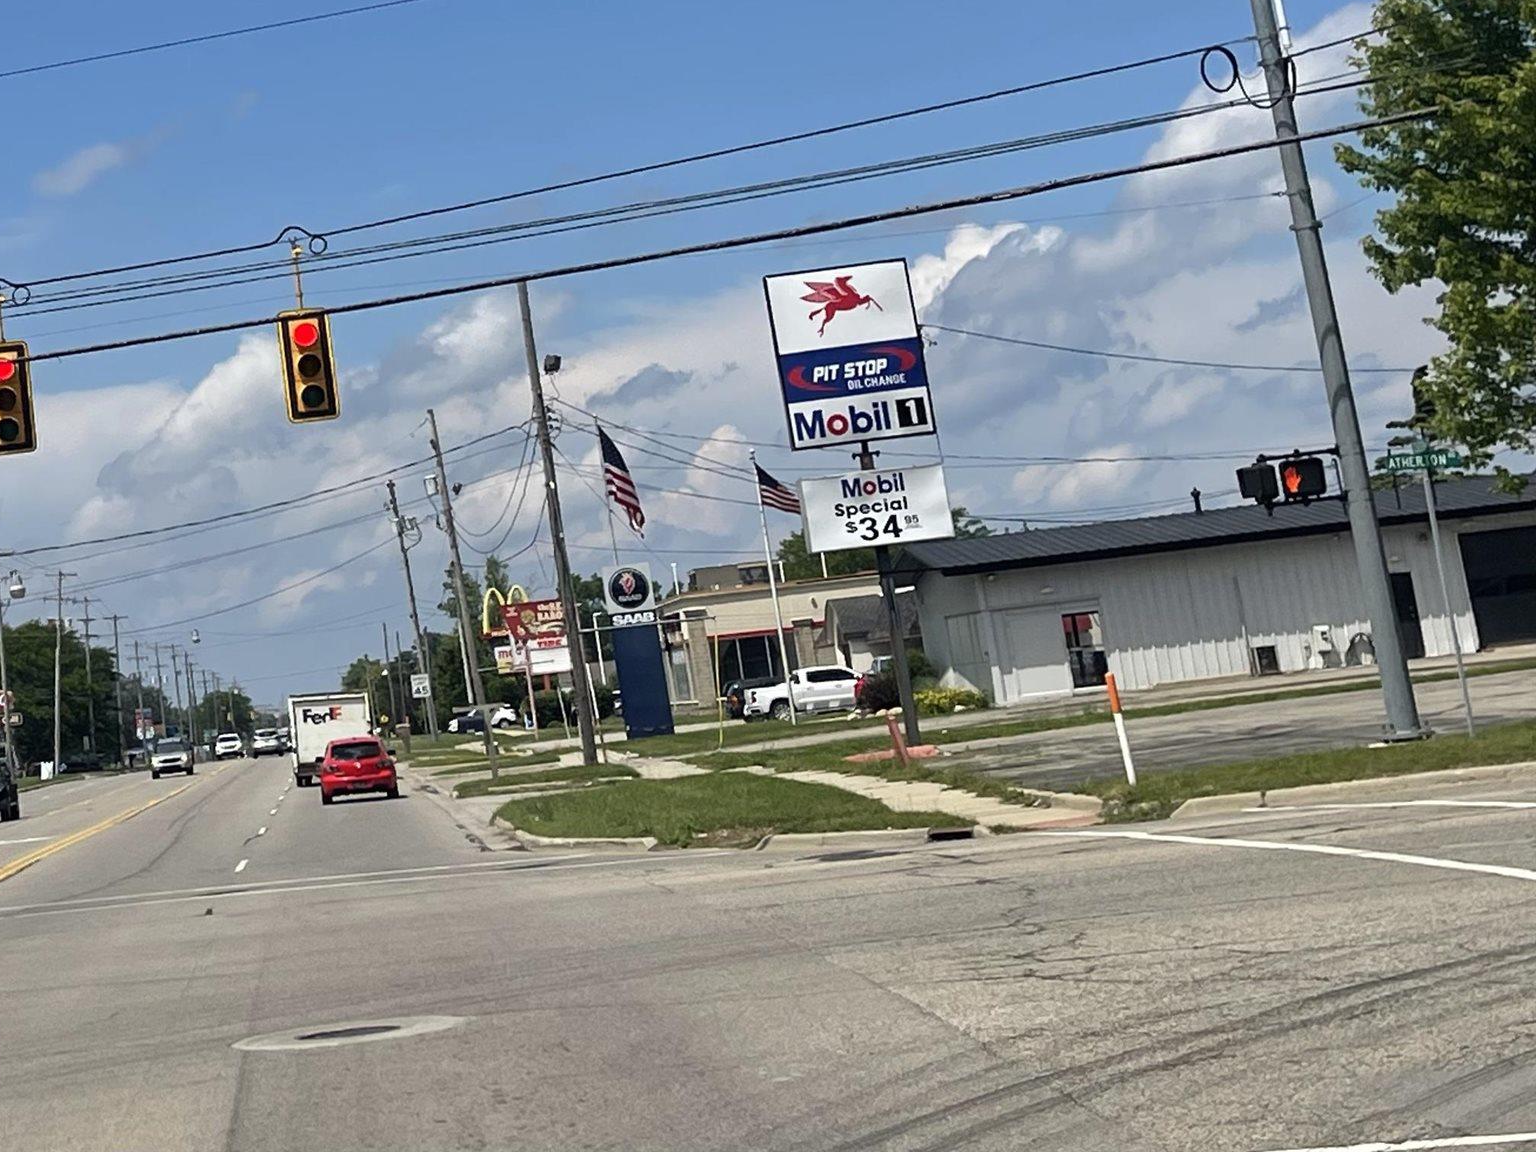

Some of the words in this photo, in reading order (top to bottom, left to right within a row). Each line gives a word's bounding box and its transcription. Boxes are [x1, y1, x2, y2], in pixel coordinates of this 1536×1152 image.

[813, 364, 840, 383] PIT
[844, 358, 888, 378] STOP
[847, 379, 864, 390] OIL
[864, 373, 907, 388] CHANGE
[793, 401, 892, 441] Mobil
[905, 399, 919, 424] 1
[840, 472, 905, 498] Mobil
[834, 496, 908, 519] Special
[845, 514, 903, 541] $34
[612, 612, 655, 627] SAAB
